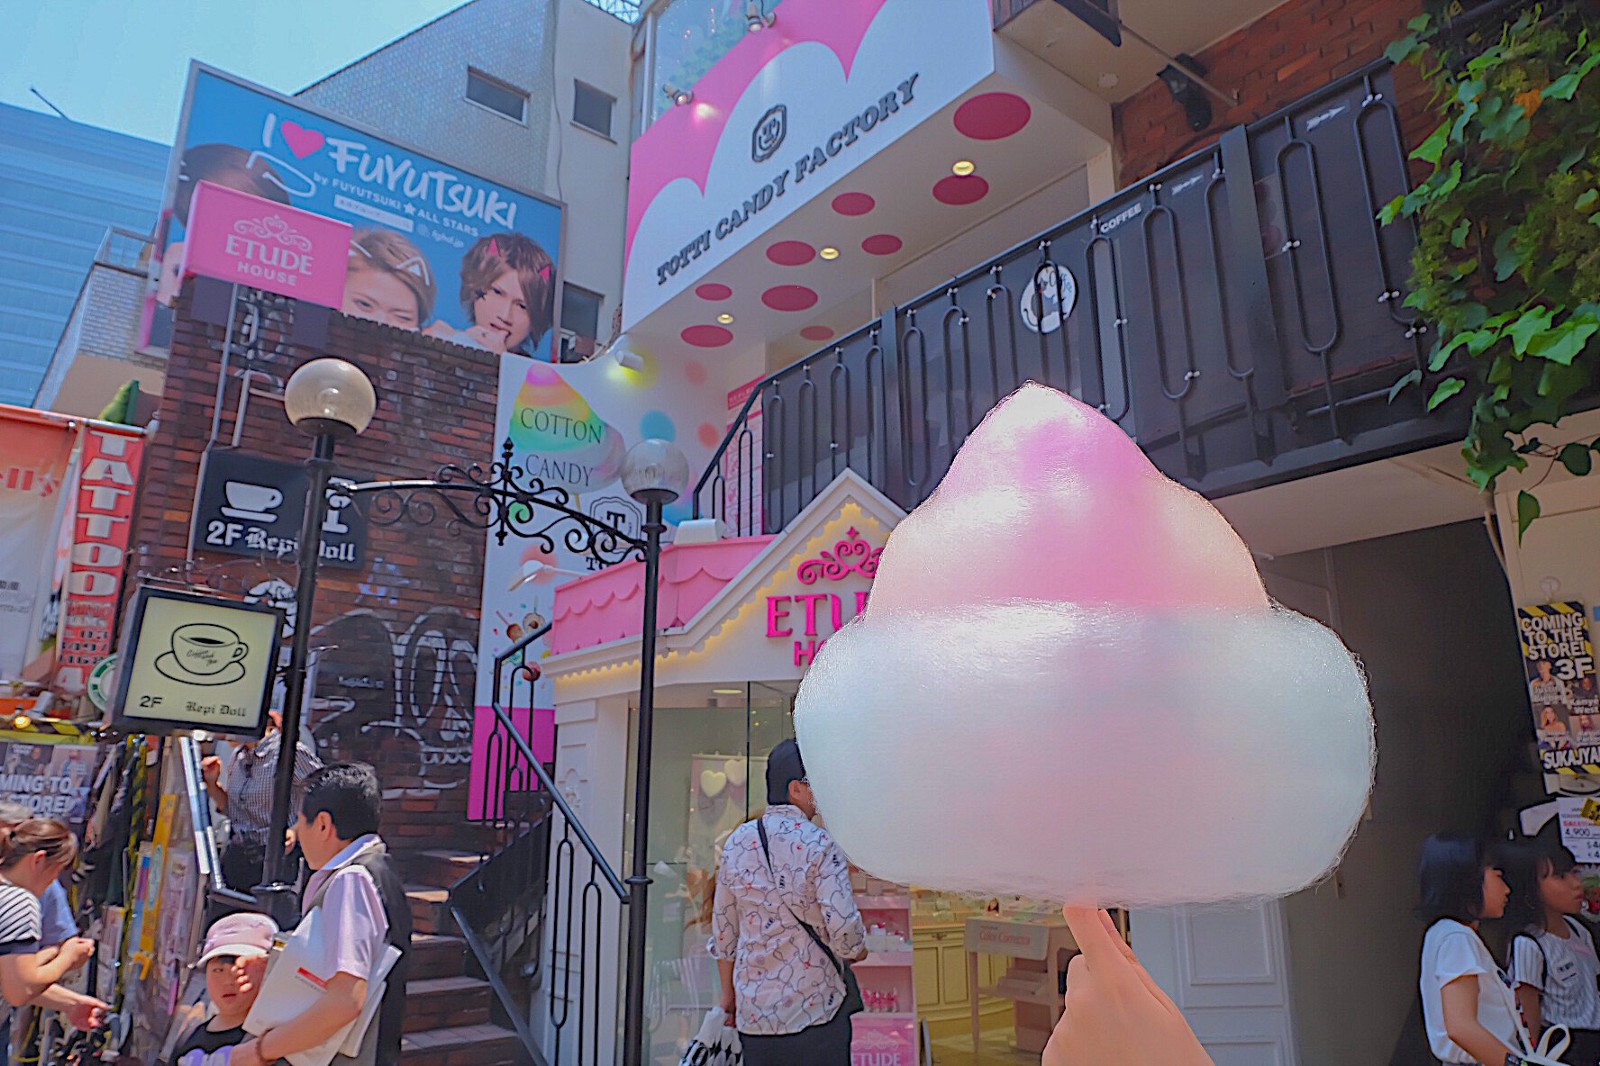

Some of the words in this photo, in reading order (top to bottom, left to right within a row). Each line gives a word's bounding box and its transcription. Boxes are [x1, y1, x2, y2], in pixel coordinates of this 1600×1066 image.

[262, 112, 277, 148] I
[657, 230, 710, 286] TOTTI
[715, 170, 789, 240] CANDY
[794, 72, 919, 184] FACTORY
[313, 171, 328, 186] by
[331, 178, 402, 209] FUYUTSUKI
[417, 208, 440, 225] ALL
[443, 217, 480, 237] STARS
[1100, 202, 1142, 233] COFFEE
[225, 233, 314, 275] ETUDE
[237, 261, 298, 287] HOUSE
[520, 407, 604, 445] COTTON
[525, 454, 594, 487] CANDY
[68, 429, 143, 597] TATTOO
[206, 520, 245, 546] 2F
[319, 540, 356, 562] oll
[766, 591, 869, 637] ETU
[1521, 612, 1584, 633] COMING
[1525, 630, 1548, 646] TO
[1550, 626, 1584, 643] THE
[1528, 641, 1587, 660] STORE!
[1555, 657, 1593, 680] 3F
[139, 696, 162, 708] 2F
[50, 776, 72, 793] TO
